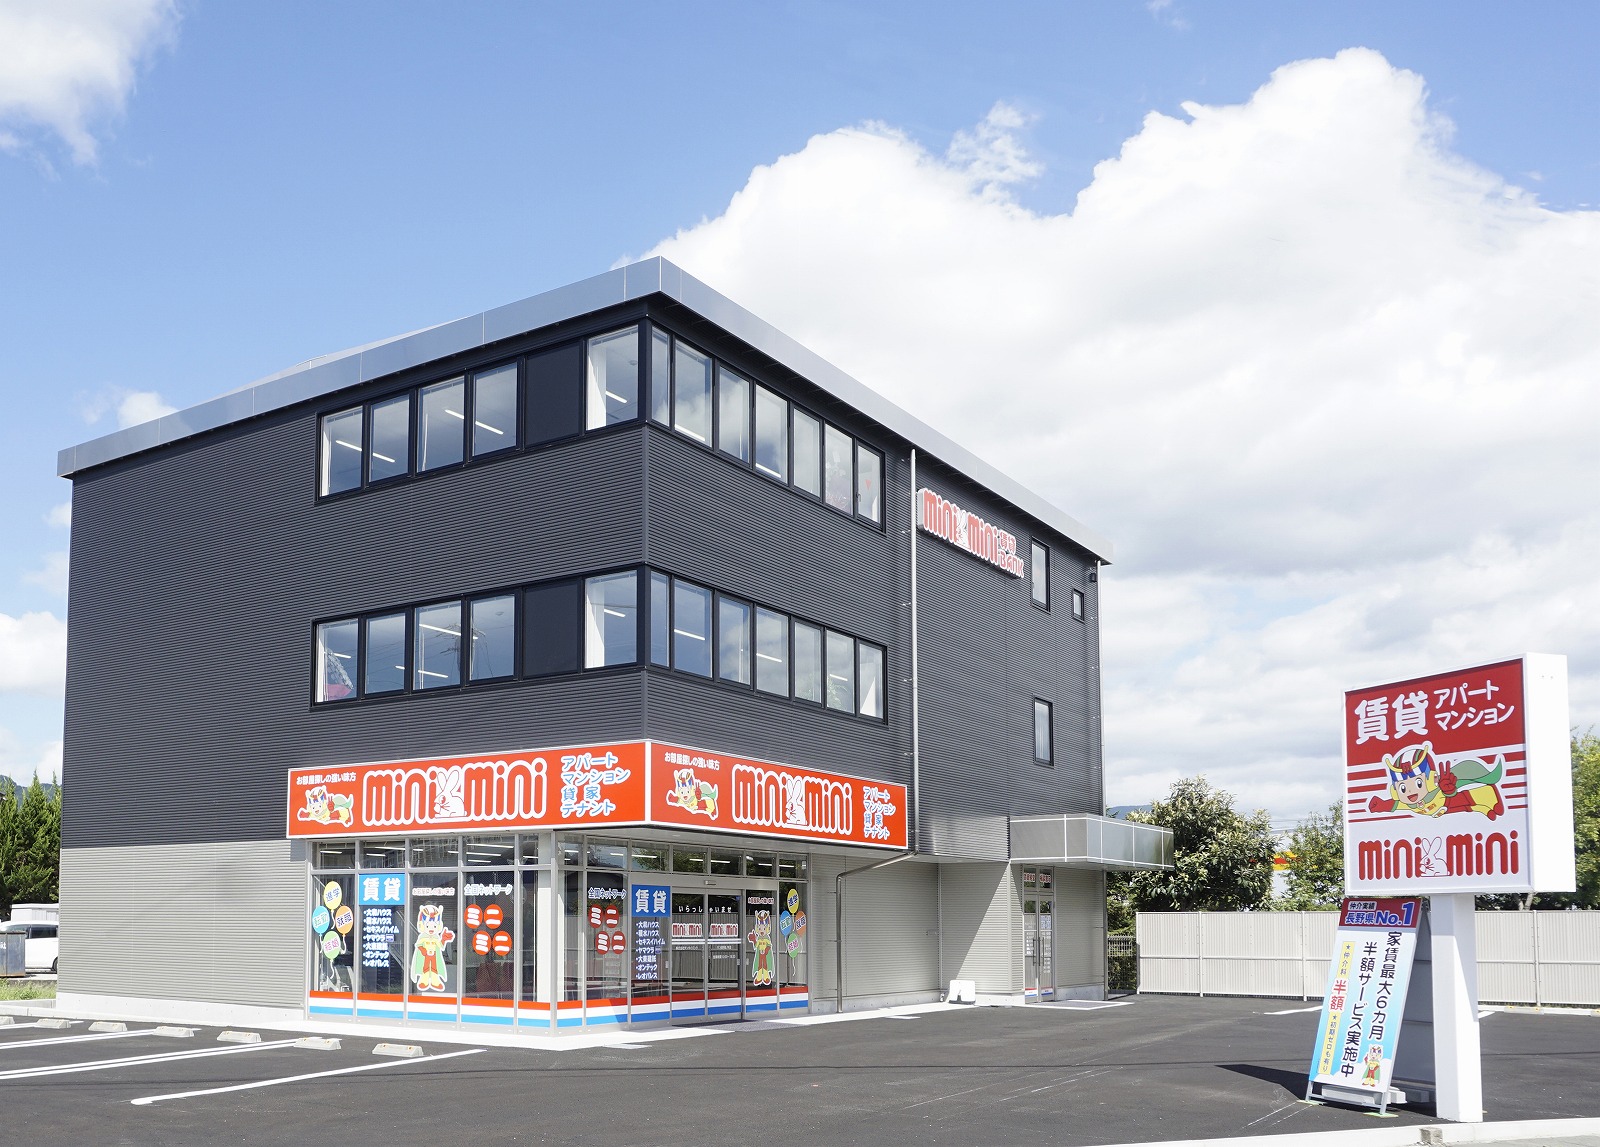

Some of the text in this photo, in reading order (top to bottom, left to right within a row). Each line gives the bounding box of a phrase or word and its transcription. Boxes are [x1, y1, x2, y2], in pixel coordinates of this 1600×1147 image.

[923, 487, 998, 565] mini mini
[1354, 680, 1499, 745] 賃貸 アパート
[1434, 703, 1515, 731] マンション
[560, 751, 618, 771] アパート
[560, 768, 631, 786] マンション
[362, 757, 547, 826] mini mini
[731, 764, 852, 836] mini mini
[862, 786, 890, 803] アパート
[560, 799, 617, 817] テナント
[862, 800, 897, 816] マンション
[863, 825, 891, 840] テナント
[1358, 829, 1519, 880] mini mini
[363, 877, 402, 902] 賃貸
[635, 889, 667, 914] 賃貸
[1349, 902, 1376, 910] 仲介実績
[467, 907, 501, 926] ミニ
[590, 907, 618, 925] ミニ
[475, 934, 510, 952] ミニ
[597, 933, 624, 952] ミニ
[1329, 979, 1347, 1011] 半額
[1340, 941, 1378, 1078] 半額サービス実施中
